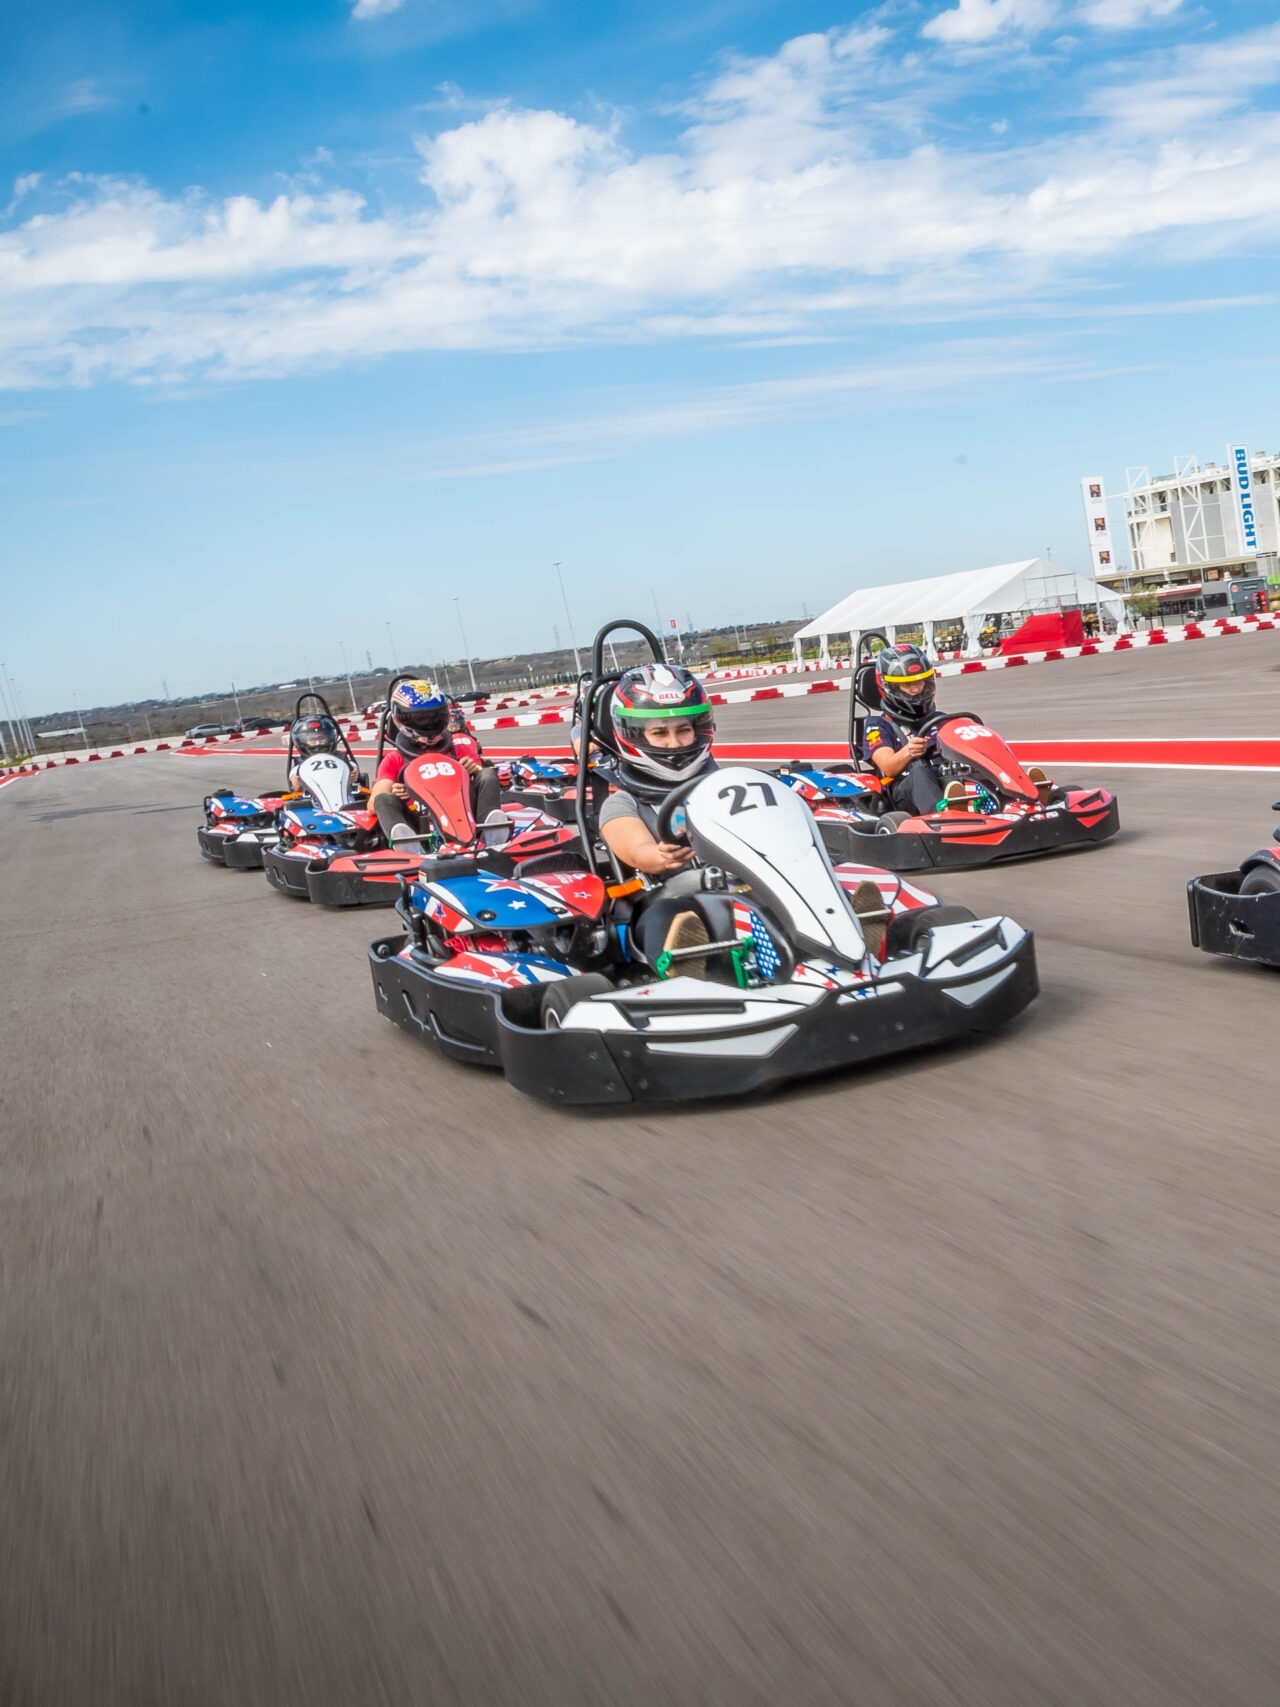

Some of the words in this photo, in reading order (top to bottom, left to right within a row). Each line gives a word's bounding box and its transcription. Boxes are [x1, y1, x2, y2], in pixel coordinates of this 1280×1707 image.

[1235, 448, 1249, 490] BUD
[1241, 493, 1257, 549] LIGHT
[658, 692, 681, 700] BELL
[311, 760, 338, 772] 26
[418, 761, 456, 780] 38
[717, 782, 778, 816] 27
